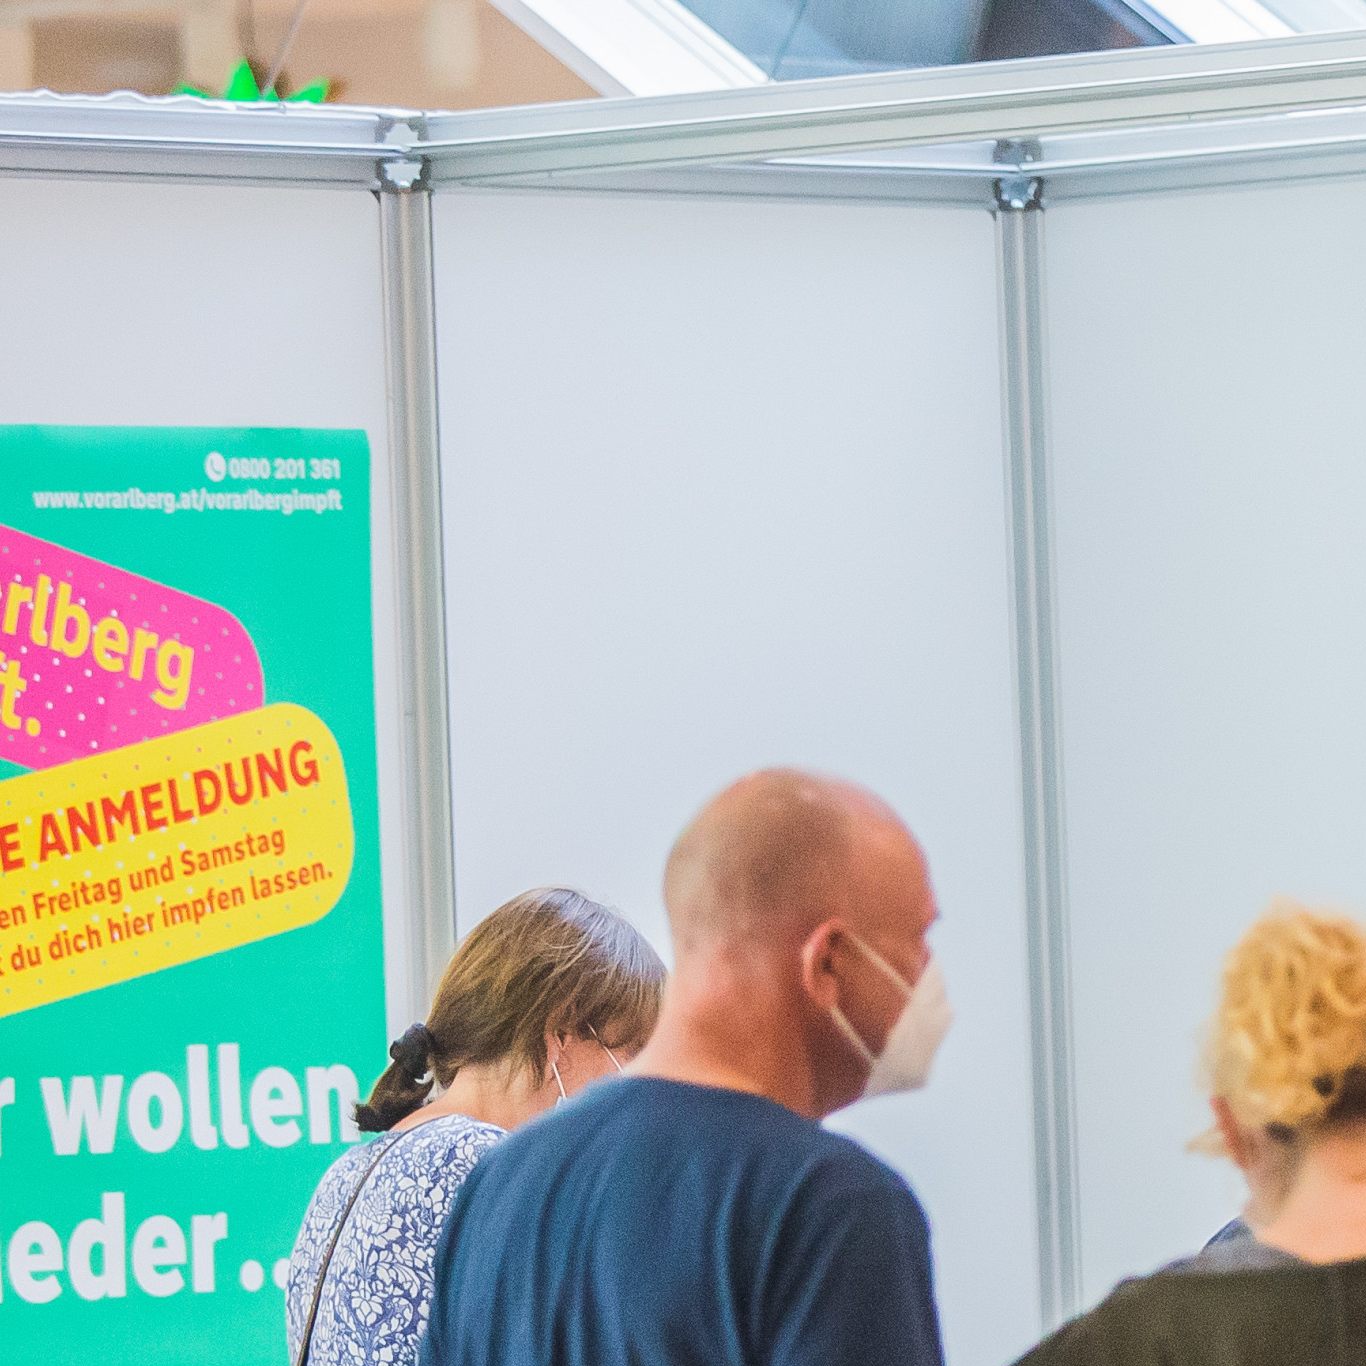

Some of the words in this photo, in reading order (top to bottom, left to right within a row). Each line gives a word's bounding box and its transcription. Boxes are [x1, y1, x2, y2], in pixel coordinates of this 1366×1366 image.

[227, 458, 271, 480] 0800
[274, 458, 305, 480] 201
[309, 457, 341, 480] 361
[0, 573, 196, 710] rlberg
[38, 739, 320, 863] ANMELDUNG
[10, 943, 42, 973] du
[48, 924, 103, 962] dich
[107, 910, 155, 944] hier
[161, 879, 246, 927] impfen
[250, 861, 334, 901] lassen.
[32, 872, 124, 920] Freitag
[129, 855, 175, 893] und
[181, 828, 286, 877] Samstag
[40, 1042, 362, 1156] wollen
